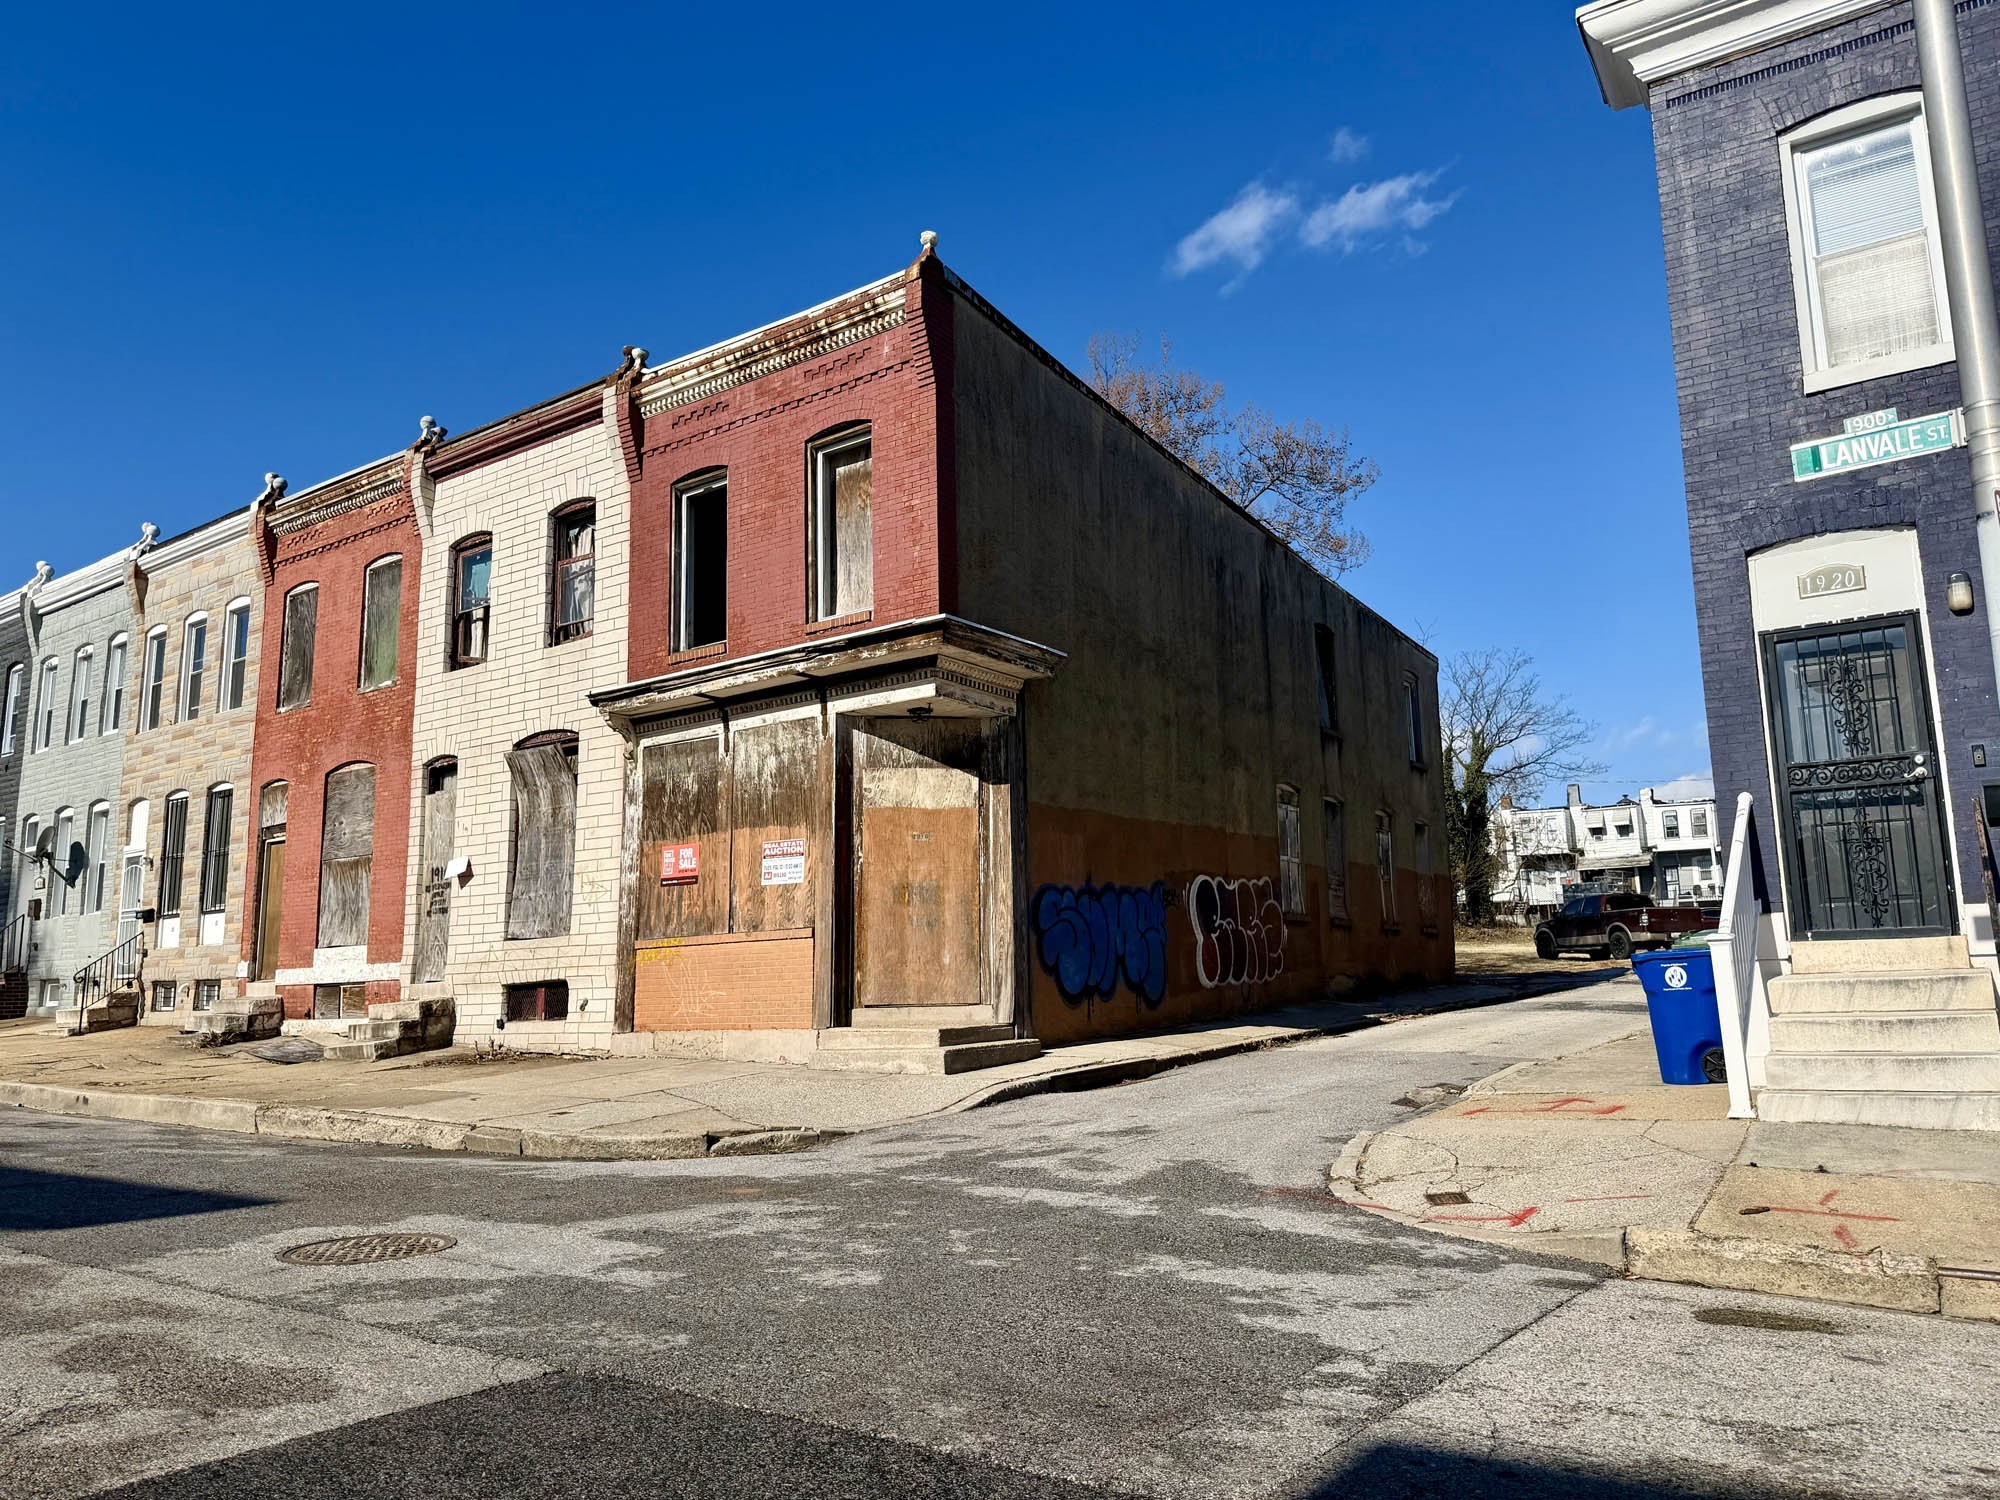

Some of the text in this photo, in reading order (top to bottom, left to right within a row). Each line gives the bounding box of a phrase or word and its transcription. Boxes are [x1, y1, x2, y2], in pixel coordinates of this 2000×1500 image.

[1820, 425, 1924, 469] LANVALE
[1806, 570, 1855, 594] 1920
[679, 847, 693, 858] FOR
[764, 846, 804, 856] AUCTION
[679, 857, 697, 869] SALE
[431, 866, 447, 882] 191
